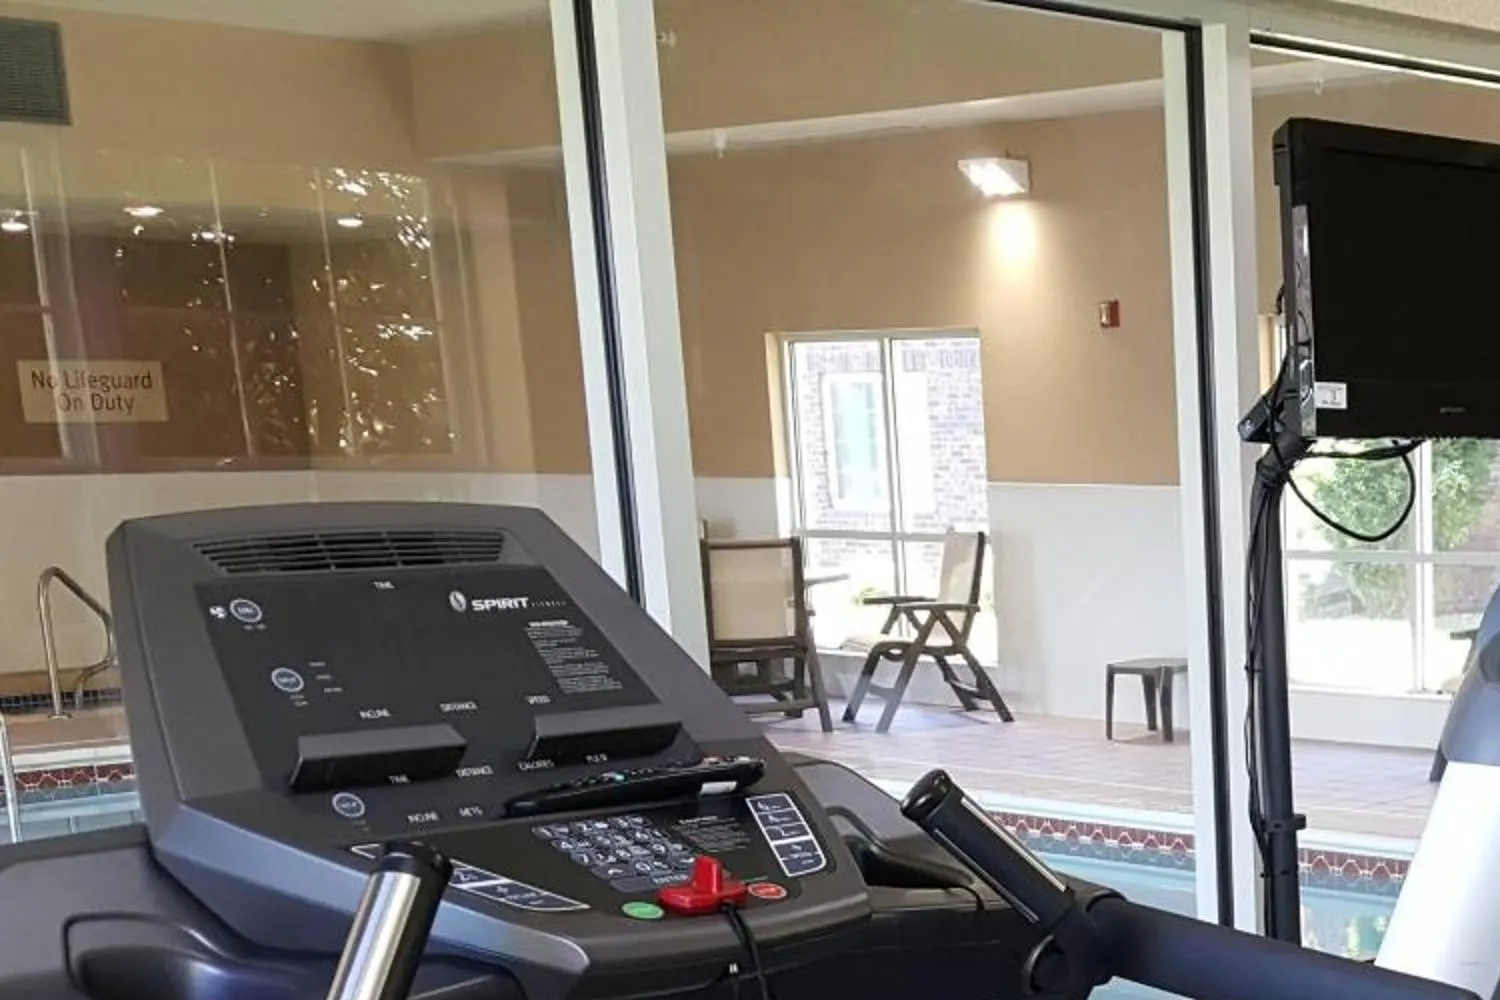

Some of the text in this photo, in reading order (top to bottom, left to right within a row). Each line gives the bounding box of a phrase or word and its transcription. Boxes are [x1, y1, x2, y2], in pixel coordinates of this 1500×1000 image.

[31, 369, 153, 392] No Lifeguard
[58, 393, 135, 415] On Duty
[471, 597, 529, 611] SPIRIT
